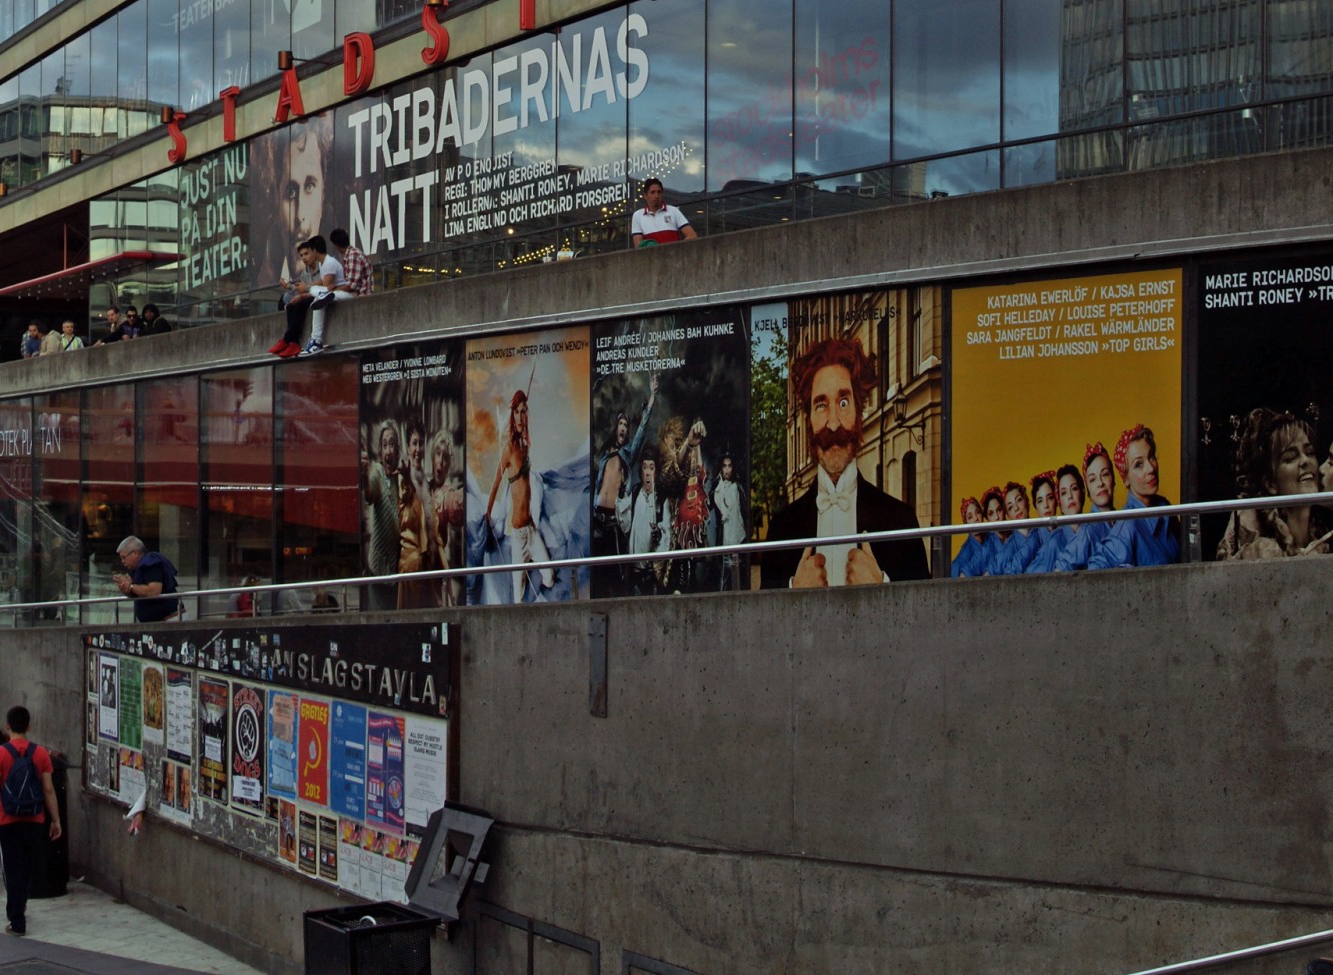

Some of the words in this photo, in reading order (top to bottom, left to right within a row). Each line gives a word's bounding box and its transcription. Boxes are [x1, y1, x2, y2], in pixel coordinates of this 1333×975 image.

[348, 14, 649, 178] TRIBADERNAS
[181, 158, 218, 210] JUST
[224, 143, 247, 187] NU
[444, 167, 455, 183] AV
[457, 166, 464, 179] P
[465, 164, 472, 178] O
[444, 206, 450, 219] I
[500, 183, 534, 207] SHANTI
[538, 173, 574, 197] RONEY,
[576, 163, 611, 186] MARIE
[613, 144, 685, 178] RICHARDSON
[445, 184, 468, 201] REGI:
[470, 174, 506, 196] THOMMY
[182, 210, 201, 250] PÅ
[206, 192, 237, 238] DIN
[349, 169, 440, 256] NATT
[444, 222, 466, 238] LINA
[509, 205, 528, 222] OCH
[530, 197, 573, 219] RICHARD
[575, 182, 631, 209] FORSGREN
[180, 235, 248, 291] TEATER:
[1205, 272, 1248, 290] MARIE
[1252, 265, 1333, 287] RICHARDSO
[987, 292, 1037, 309] KATARINA
[1040, 286, 1089, 305] EWERLÖF
[1100, 284, 1136, 300] KAJSA
[1138, 280, 1176, 296] ERNST
[1204, 290, 1254, 309] SHANTI
[1258, 286, 1304, 305] RONEY
[754, 318, 779, 332] KJELL
[977, 312, 1001, 327] SOFI
[1004, 308, 1056, 325] HELLEDAY
[1066, 304, 1106, 321] LOUISE
[1109, 298, 1176, 317] PETERHOFF
[596, 336, 611, 349] LEIF
[613, 331, 640, 347] ANDRÉE
[647, 329, 685, 342] JOHANNES
[686, 326, 701, 339] BAH
[703, 322, 735, 337] KUHNKE
[966, 330, 992, 345] SARA
[994, 326, 1052, 343] JANGFELDT
[1063, 322, 1098, 338] RAKEL
[1101, 317, 1175, 336] WÄRMLÄNDER
[468, 350, 485, 361] ANTON
[486, 347, 515, 360] LUNDQVIST
[539, 343, 551, 354] PAN
[552, 342, 564, 352] OCH
[596, 349, 626, 362] ANDREAS
[628, 345, 659, 358] KUNDLER
[999, 345, 1034, 360] LILIAN
[1037, 340, 1099, 358] JOHANSSON
[1101, 338, 1130, 353] »TOP
[1133, 335, 1175, 352] GIRLS«
[611, 362, 624, 374] TRE
[21, 426, 61, 456] PLTAN
[270, 649, 437, 706] ANSLAGSTAVLA
[233, 686, 264, 717] STREET
[304, 782, 321, 799] 2012
